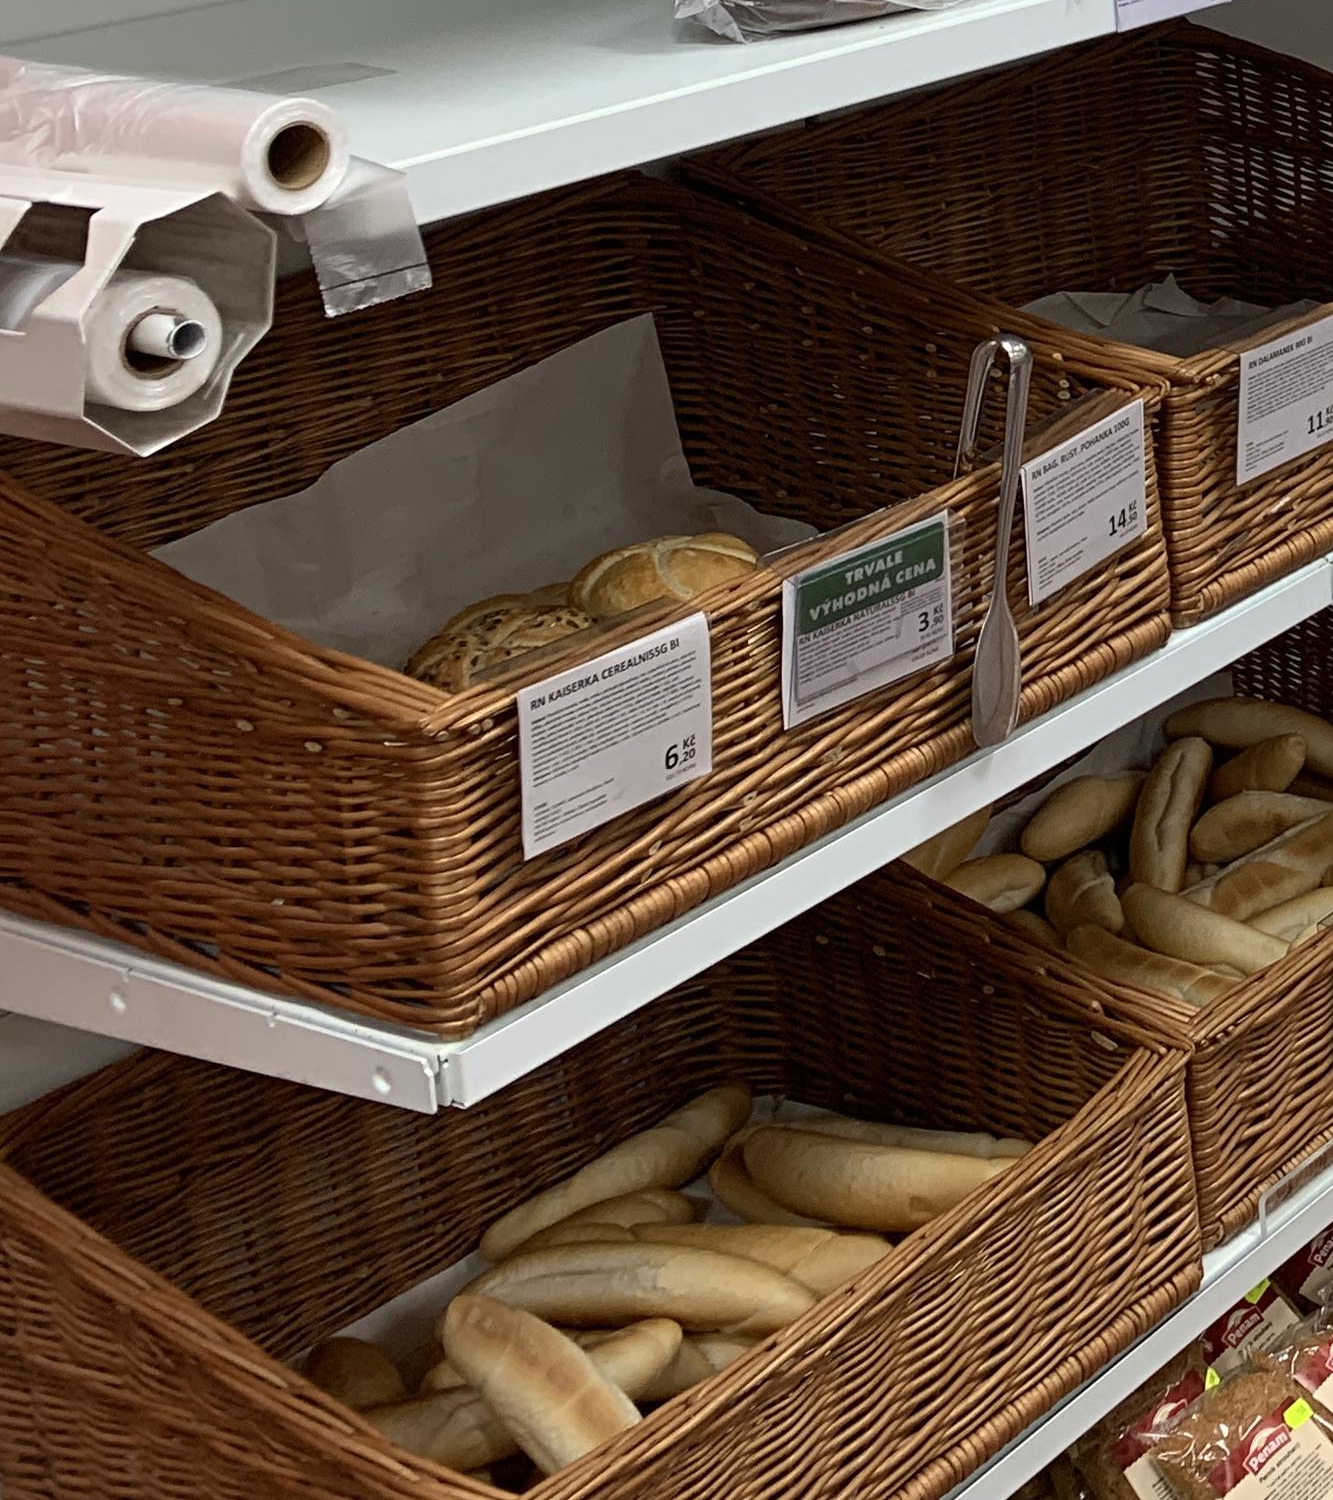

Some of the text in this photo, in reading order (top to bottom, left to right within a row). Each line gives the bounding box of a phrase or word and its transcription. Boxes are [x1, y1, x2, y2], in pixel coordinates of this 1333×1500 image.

[1080, 427, 1113, 452] POHANKA
[1113, 416, 1130, 433] 100G
[1307, 411, 1324, 435] 11
[1109, 508, 1127, 537] 14
[844, 550, 904, 586] TRVALE
[808, 557, 936, 621] VÝHODNÁ CENA
[918, 611, 930, 633] 3
[530, 697, 546, 711] RN
[548, 673, 599, 704] KAISERKA
[670, 637, 680, 651] BI
[665, 734, 696, 770] 6 Kč
[1227, 1311, 1262, 1347] Penam
[1248, 1429, 1290, 1474] Penam
